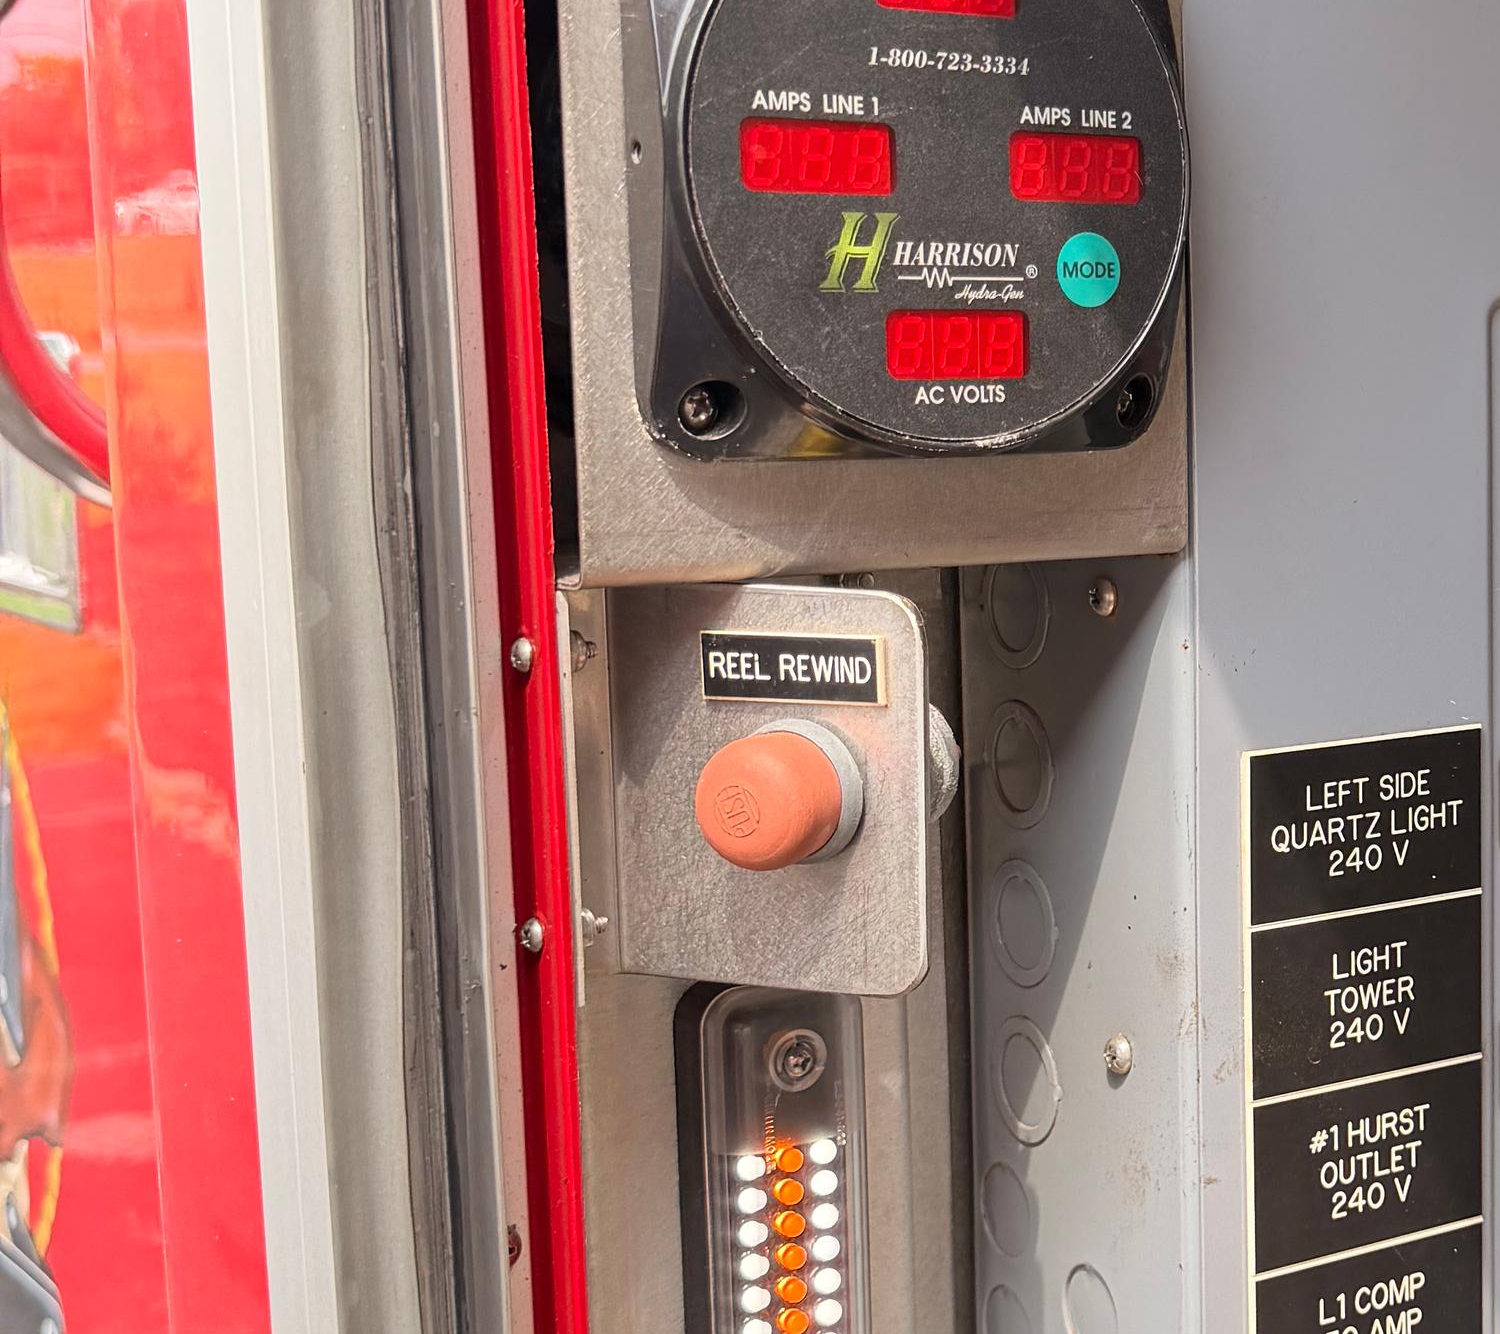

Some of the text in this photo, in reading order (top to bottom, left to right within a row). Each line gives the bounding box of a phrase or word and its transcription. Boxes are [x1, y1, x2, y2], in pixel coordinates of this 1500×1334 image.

[868, 46, 1030, 76] 1-800-723-3334
[752, 90, 879, 116] AMPS LINE 1
[1021, 106, 1132, 129] AMPS LINE 2
[819, 212, 900, 293] H
[893, 242, 1019, 267] HARRISON
[1062, 262, 1116, 279] MODE
[955, 284, 1024, 305] Hydra-Gen
[915, 385, 1006, 405] AC VOLTS
[709, 652, 872, 684] REEL REWIND
[1306, 769, 1431, 811] LEFT SIDE
[1271, 800, 1463, 853] QUARTZ LIGHT
[1329, 839, 1409, 877] 240 V
[1333, 941, 1407, 980] LIGHT
[1324, 976, 1415, 1016] TOWER
[1330, 1007, 1410, 1048] 240 V
[1309, 1104, 1430, 1153] #1 HURST
[1320, 1140, 1422, 1189] OUTLET
[1332, 1175, 1412, 1219] 240 V
[1355, 1272, 1426, 1315] COMP
